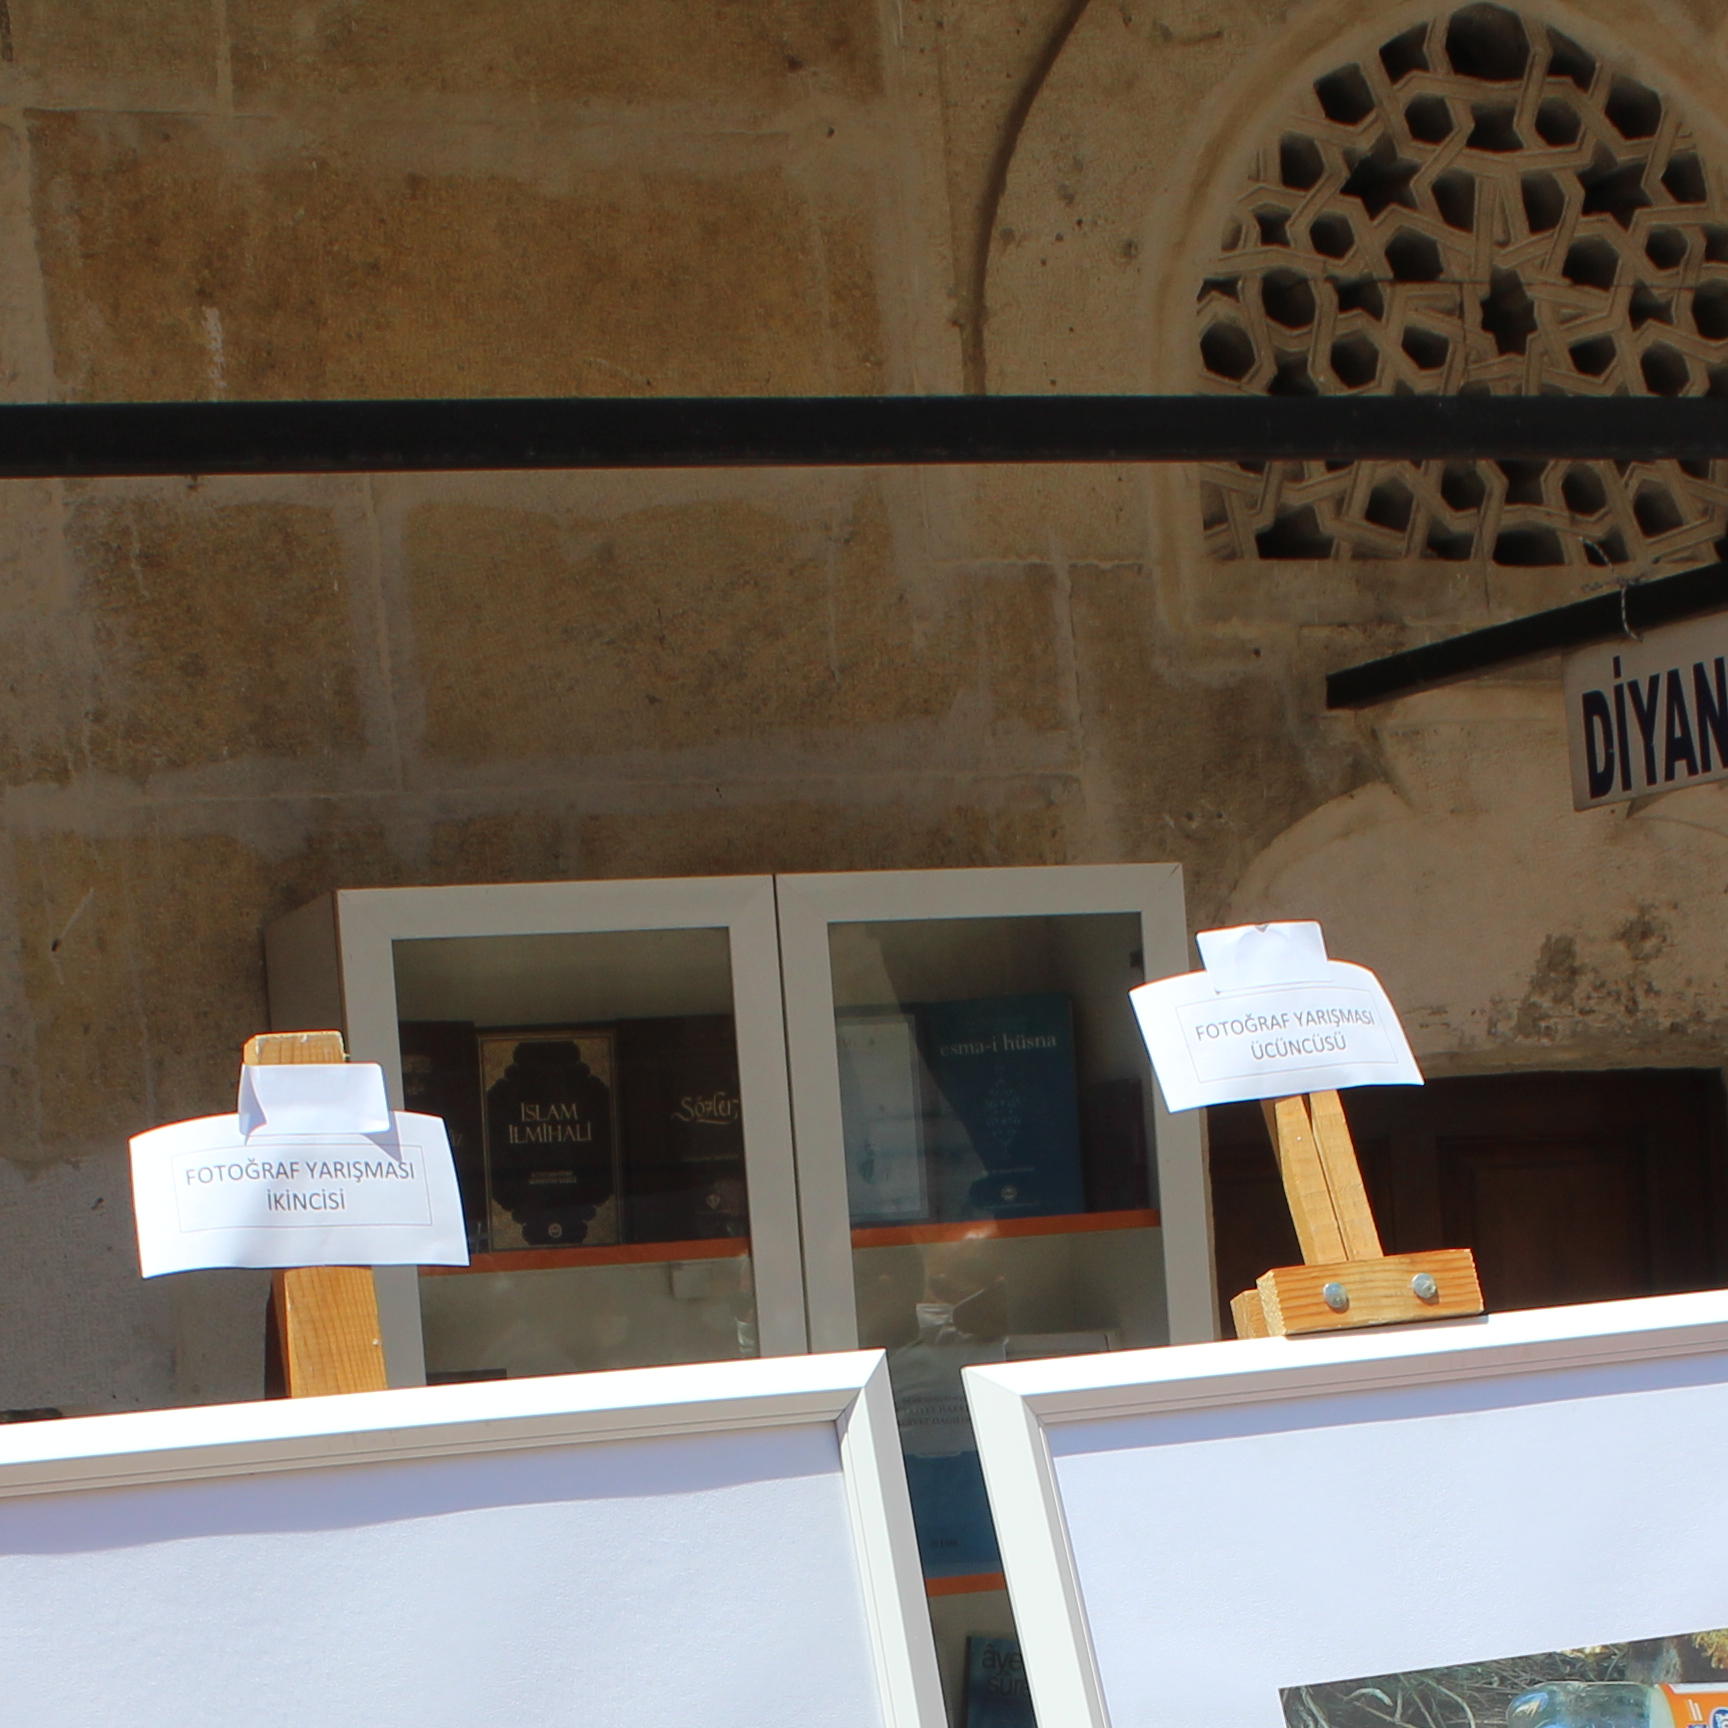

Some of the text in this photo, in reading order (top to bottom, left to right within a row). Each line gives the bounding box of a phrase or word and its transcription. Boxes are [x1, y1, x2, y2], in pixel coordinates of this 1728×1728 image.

[1195, 1008, 1375, 1041] FOTOĞRAF YARIŞMASI
[1003, 1033, 1057, 1052] hüsna
[186, 1158, 415, 1186] FOTOĞRAF YARIŞMASI
[267, 1188, 346, 1212] İKİNCİSİ
